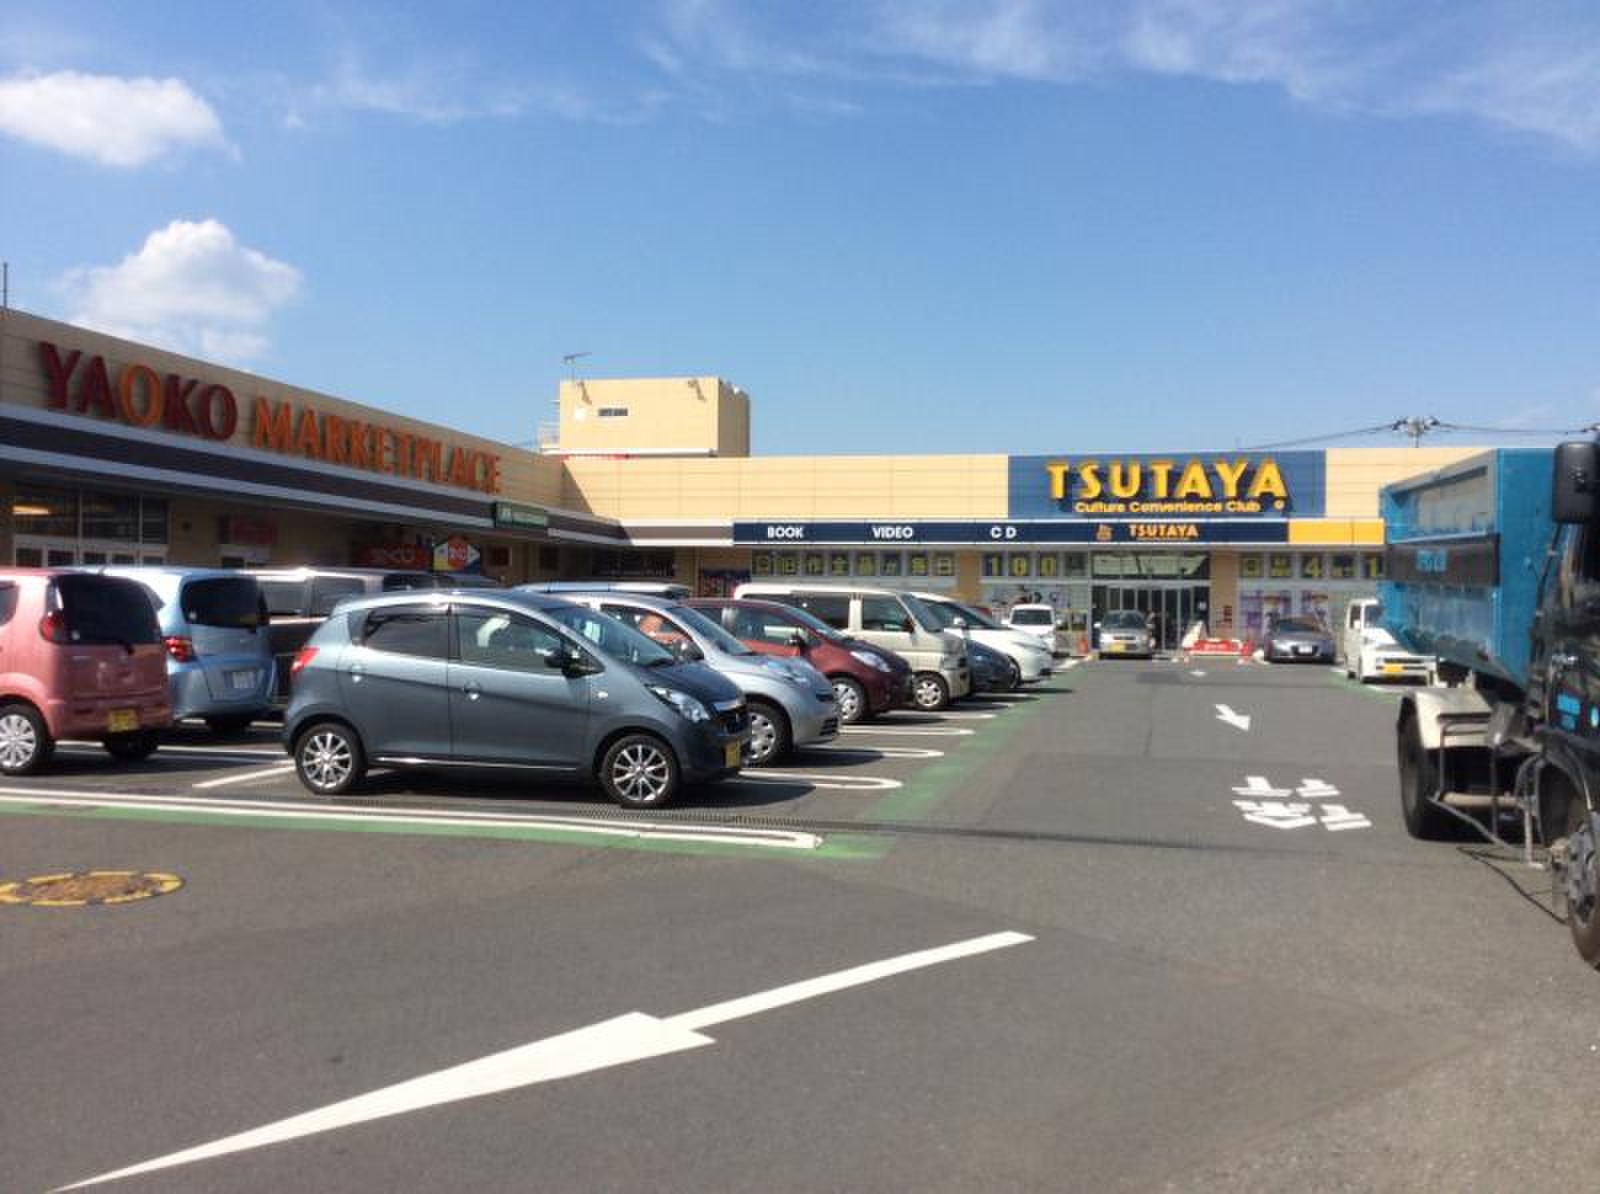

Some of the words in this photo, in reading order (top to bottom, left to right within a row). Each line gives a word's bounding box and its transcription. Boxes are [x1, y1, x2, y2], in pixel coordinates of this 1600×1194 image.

[38, 341, 238, 442] YAOKO
[254, 396, 502, 495] MARKETPLACE
[1047, 458, 1288, 499] TSUTAYA
[1074, 501, 1125, 513] Culture
[1129, 501, 1222, 513] Convenience
[1226, 501, 1261, 513] Club
[767, 526, 804, 539] BOOK
[872, 526, 914, 539] VIDEO
[1129, 524, 1199, 538] TSUTAYA
